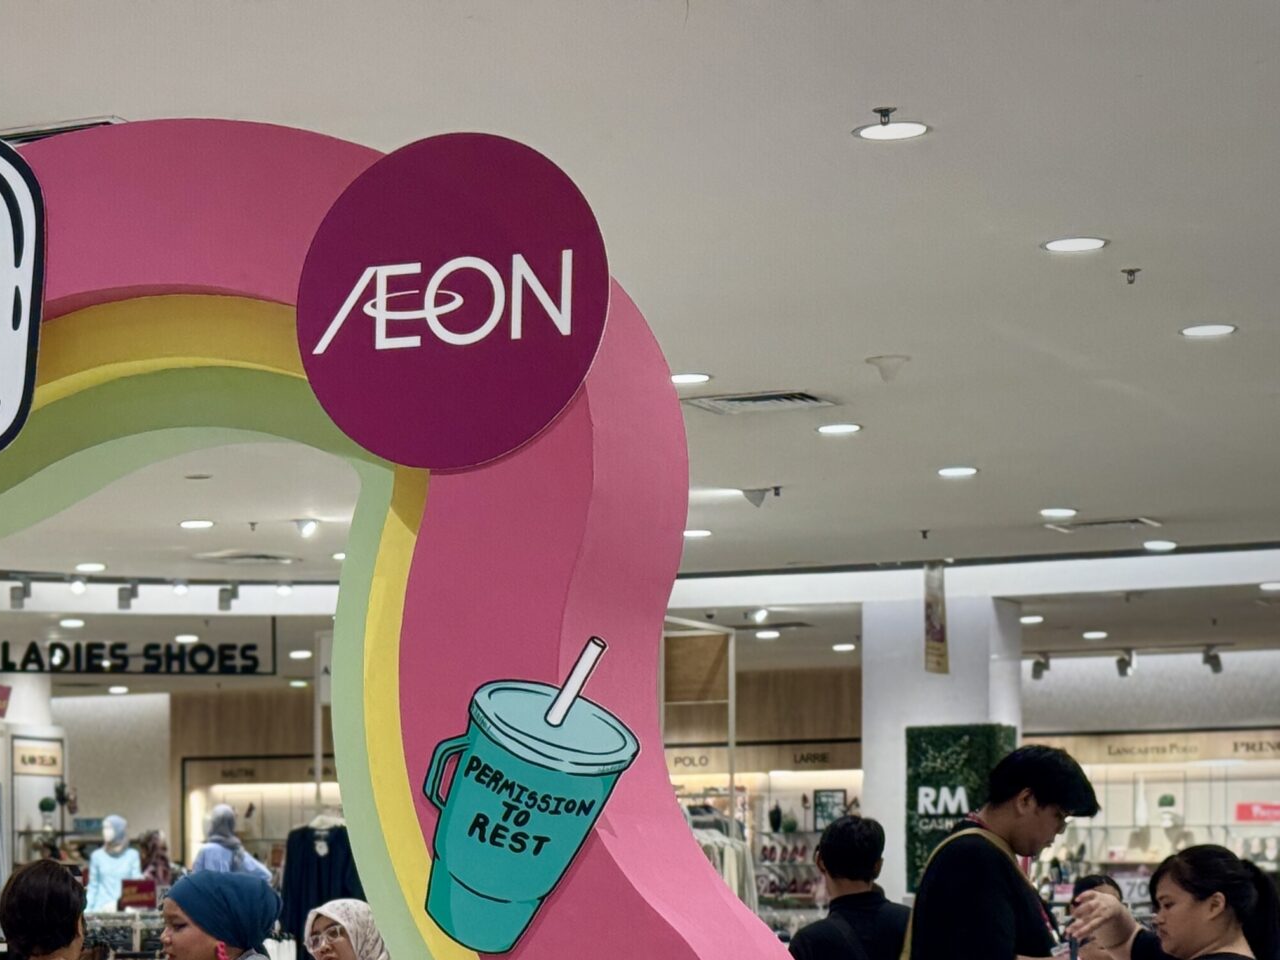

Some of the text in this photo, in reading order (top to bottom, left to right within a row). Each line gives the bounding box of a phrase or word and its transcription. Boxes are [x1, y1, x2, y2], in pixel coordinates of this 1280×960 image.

[0, 640, 260, 674] LADIES SHOES
[674, 755, 710, 767] POLO
[794, 752, 830, 764] LARRIE
[463, 755, 597, 817] PERMISSION
[501, 801, 530, 827] TO
[917, 786, 970, 815] RM
[468, 813, 551, 856] REST
[919, 818, 954, 831] CASH
